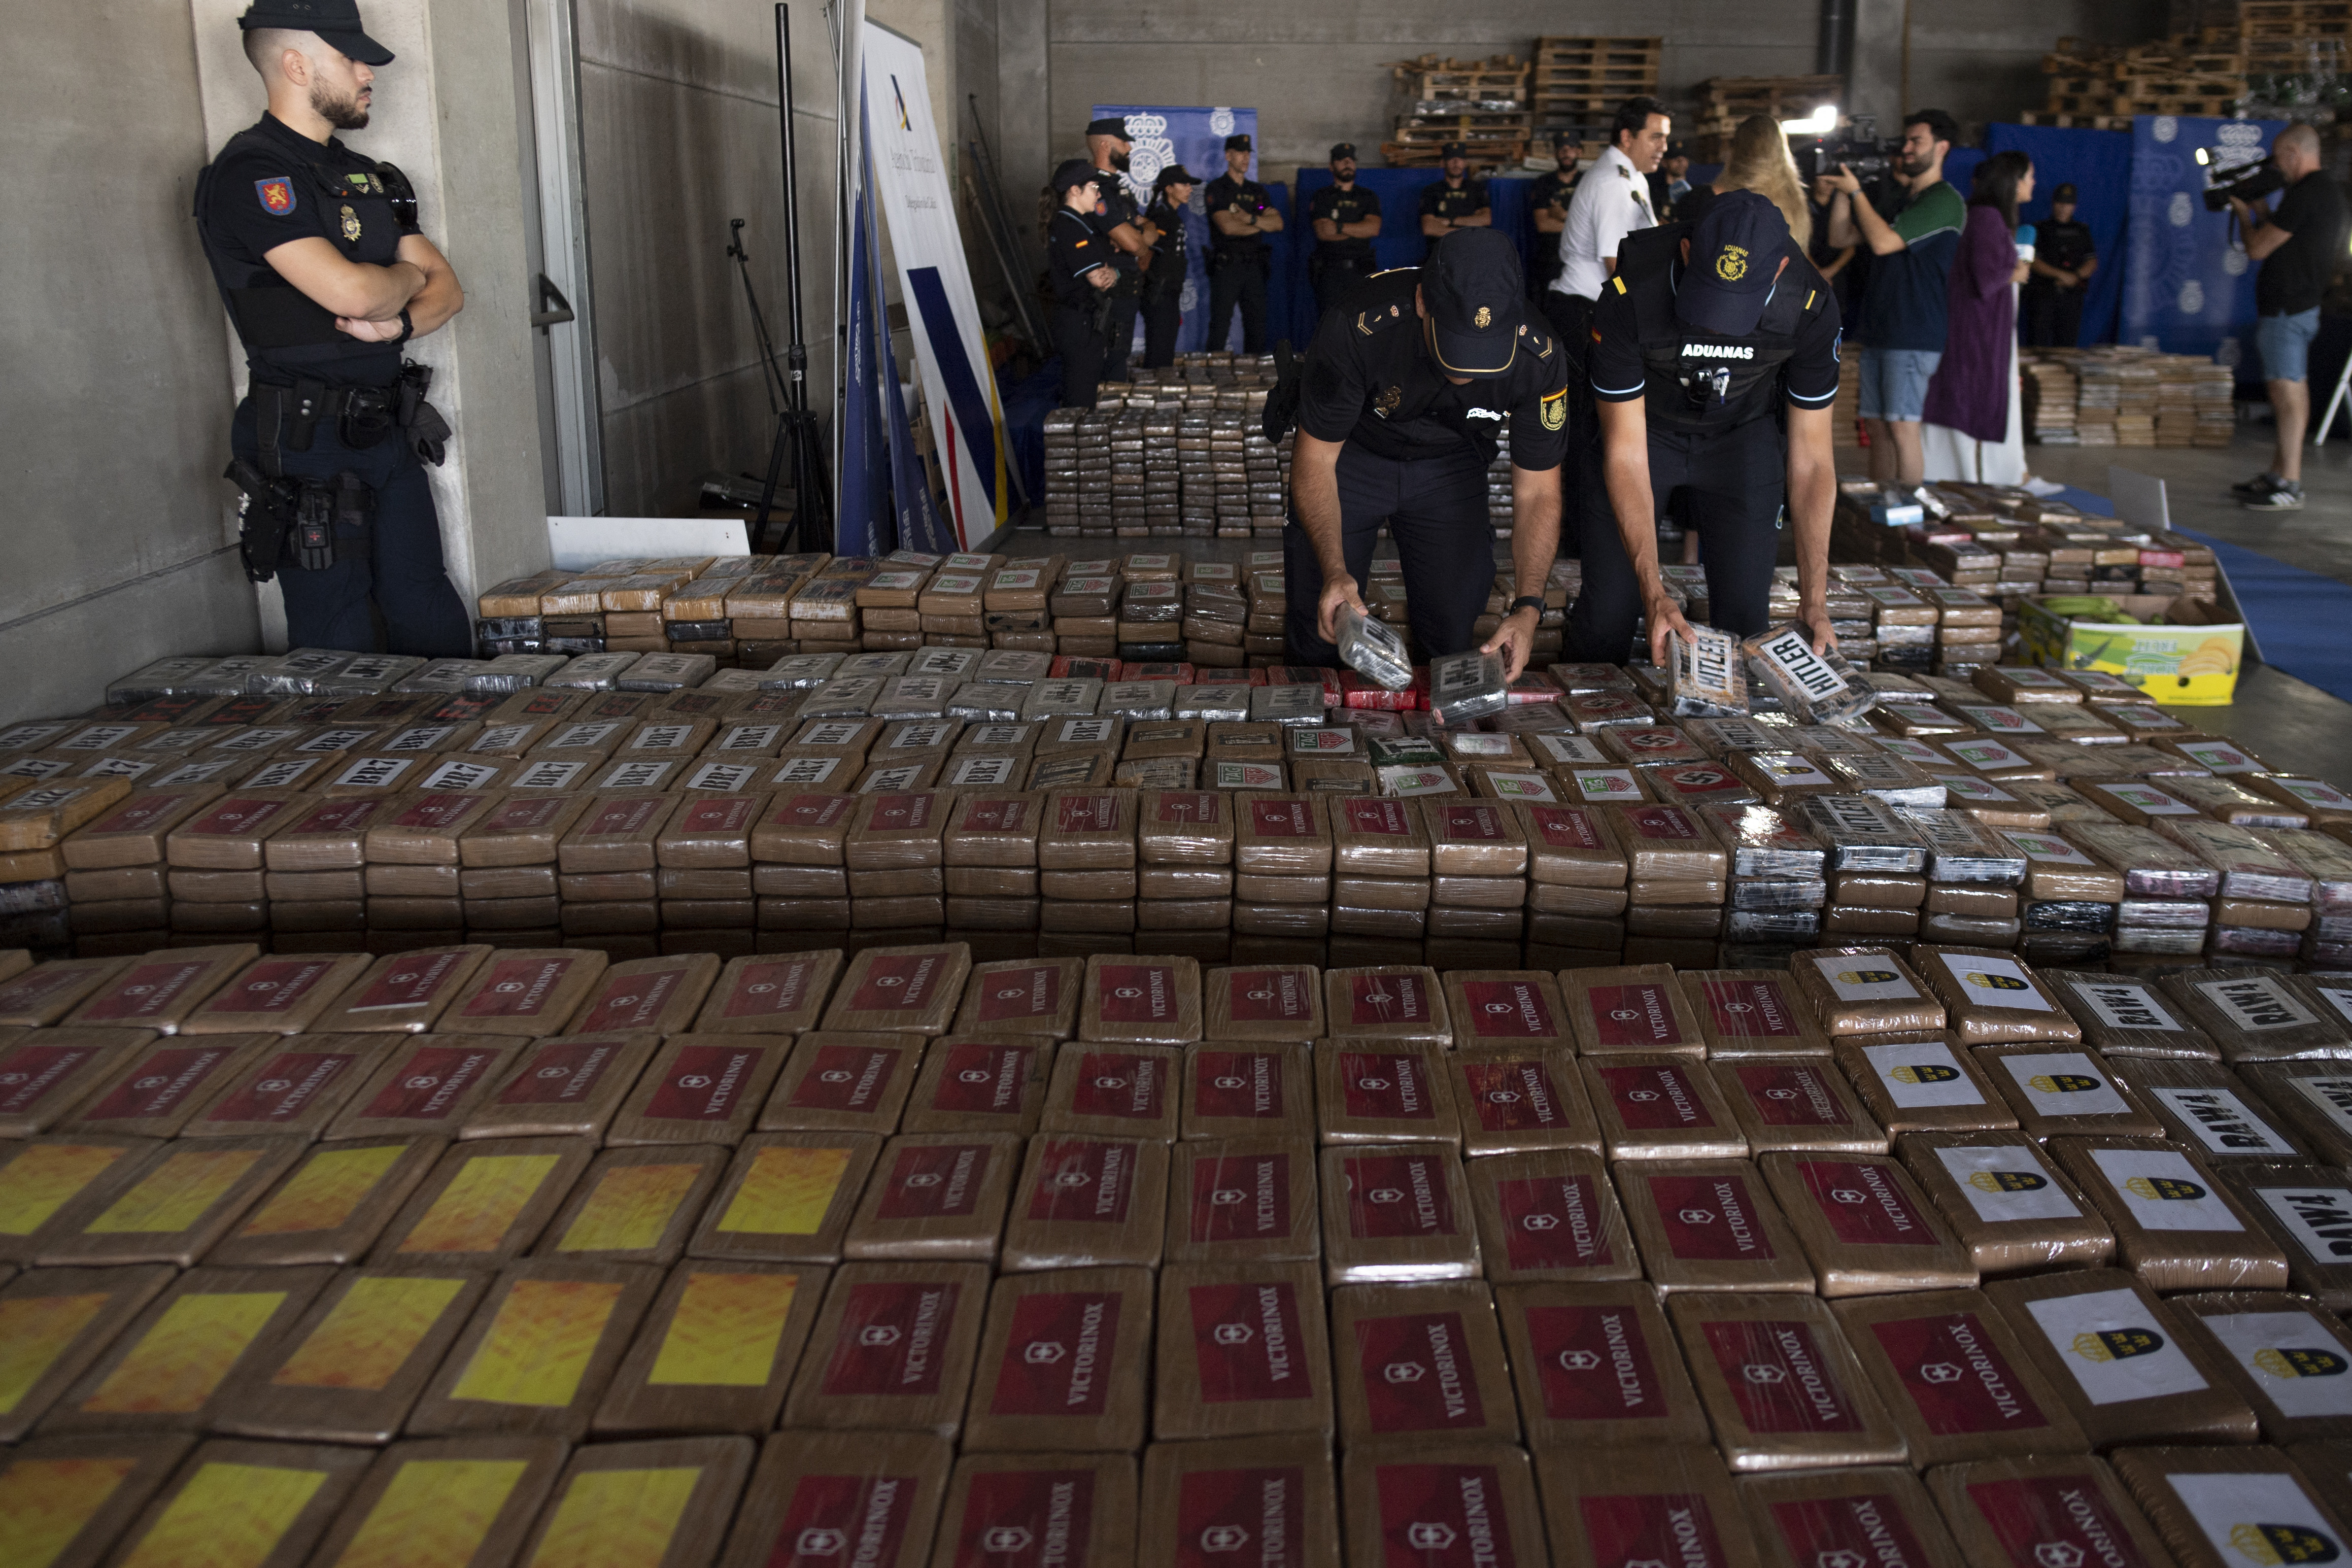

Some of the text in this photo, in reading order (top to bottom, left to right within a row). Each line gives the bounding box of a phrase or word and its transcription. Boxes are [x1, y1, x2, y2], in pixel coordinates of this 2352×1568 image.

[1724, 244, 1748, 257] ADUANAS
[1682, 344, 1754, 359] ADUANAS
[1697, 637, 1726, 689] HITLER
[1772, 638, 1838, 695] HITLER
[68, 728, 124, 747] BR7
[228, 730, 282, 748] BR7
[308, 731, 362, 751] BR7
[395, 727, 441, 750] BR7
[480, 726, 522, 749] BR7
[560, 724, 606, 746] BR7
[643, 726, 681, 747] BR7
[730, 726, 769, 748] BR7
[810, 724, 854, 744] BR7
[901, 724, 944, 747] BR7
[983, 726, 1019, 743] BR7
[1070, 721, 1102, 740] BR7
[1301, 733, 1316, 747] TAG
[1321, 732, 1343, 748] HEUER
[7, 761, 57, 777] R7
[92, 761, 140, 777] R7
[253, 760, 306, 788] BR7
[347, 760, 399, 785] BR7
[434, 764, 485, 790] BR7
[525, 764, 571, 785] BR7
[613, 764, 658, 786] BR7
[699, 766, 735, 790] BR7
[792, 759, 830, 781] BR7
[873, 769, 912, 791] BR7
[964, 759, 1009, 782] BR7
[1225, 767, 1242, 781] TAG
[1246, 768, 1272, 783] HEUER
[230, 804, 277, 833] VICTORINOX
[435, 798, 471, 824] VICTORINOX
[527, 800, 559, 826] VICTORINOX
[623, 802, 654, 830] VICTORINOX
[722, 802, 746, 828] VICTORINOX
[816, 798, 843, 824] VICTORINOX
[909, 797, 928, 827] VICTORINOX
[1001, 803, 1019, 828] VICTORINOX
[1098, 798, 1110, 827] VICTORINOX
[1199, 796, 1209, 820] VICTORINOX
[1291, 804, 1304, 833] VICTORINOX
[1383, 802, 1398, 831] VICTORINOX
[1476, 809, 1494, 836] VICTORINOX
[1662, 810, 1690, 837] VICTORINOX
[1829, 799, 1888, 833] HITLER
[1569, 813, 1592, 845] VICTORINOX
[139, 966, 198, 1012] VICTORINOX
[264, 965, 320, 1007] VICTORINOX
[408, 954, 456, 998] VICTORINOX
[517, 963, 561, 1010] VICTORINOX
[777, 963, 806, 1008] VICTORINOX
[902, 959, 936, 1005] VICTORINOX
[1032, 971, 1047, 1012] VICTORINOX
[1150, 970, 1166, 1017] VICTORINOX
[1281, 975, 1298, 1015] VICTORINOX
[631, 975, 674, 1022] VICTORINOX
[1400, 978, 1416, 1017] VICTORINOX
[1514, 985, 1542, 1032] VICTORINOX
[1641, 989, 1668, 1039] VICTORINOX
[1753, 985, 1783, 1031] VICTORINOX
[2091, 988, 2163, 1026] RAW4
[2217, 983, 2299, 1024] RAW4
[3, 1052, 83, 1107] VICTORINOX
[145, 1052, 220, 1111] VICTORINOX
[271, 1059, 341, 1115] VICTORINOX
[421, 1055, 485, 1111] VICTORINOX
[560, 1047, 610, 1098] VICTORINOX
[704, 1054, 749, 1114] VICTORINOX
[848, 1053, 888, 1105] VICTORINOX
[993, 1050, 1019, 1107] VICTORINOX
[1132, 1060, 1154, 1112] VICTORINOX
[1254, 1057, 1270, 1112] VICTORINOX
[1396, 1059, 1418, 1112] VICTORINOX
[1521, 1068, 1554, 1123] VICTORINOX
[1658, 1070, 1697, 1121] VICTORINOX
[2175, 1095, 2270, 1147] RAW4
[943, 1150, 976, 1209] VICTORINOX
[1096, 1148, 1122, 1214] VICTORINOX
[1256, 1161, 1275, 1231] VICTORINOX
[1409, 1162, 1437, 1229] VICTORINOX
[1858, 1166, 1913, 1231] VICTORINOX
[1562, 1184, 1594, 1257] VICTORINOX
[1713, 1182, 1757, 1251] VICTORINOX
[902, 1291, 941, 1385] VICTORINOX
[1259, 1287, 1290, 1381] VICTORINOX
[1067, 1303, 1104, 1405] VICTORINOX
[1427, 1323, 1467, 1418] VICTORINOX
[1601, 1314, 1644, 1408] VICTORINOX
[1948, 1323, 2022, 1419] VICTORINOX
[1776, 1330, 1840, 1421] VICTORINOX
[2059, 1489, 2125, 1568] ORINOX
